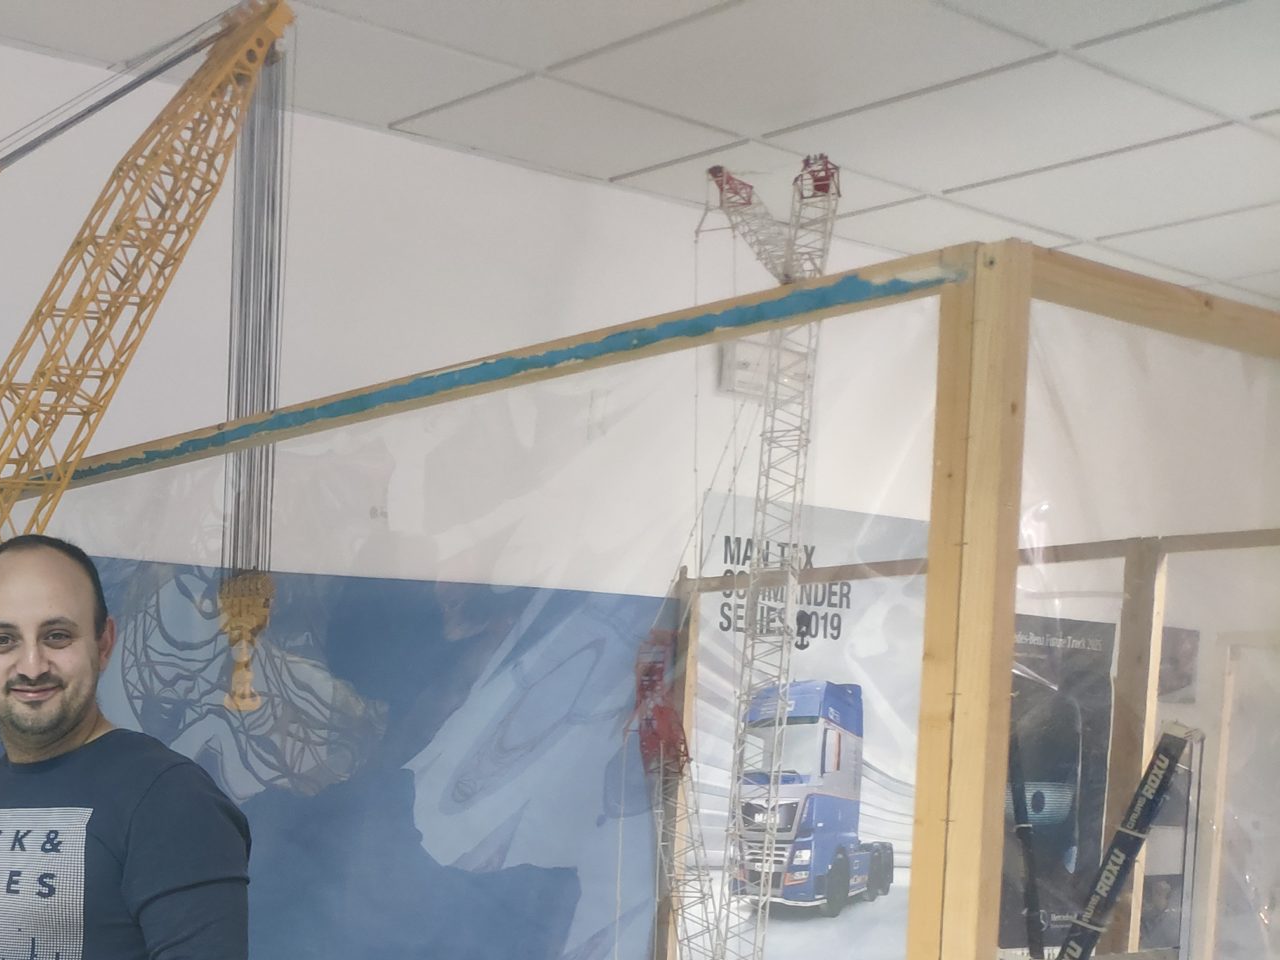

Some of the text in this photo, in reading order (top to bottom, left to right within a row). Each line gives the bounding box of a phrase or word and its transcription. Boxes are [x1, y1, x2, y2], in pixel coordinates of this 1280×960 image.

[723, 535, 770, 567] MAN
[718, 602, 842, 640] SEIES 019
[1141, 752, 1170, 800] ROXU
[1081, 847, 1127, 923] RUAS ROXU
